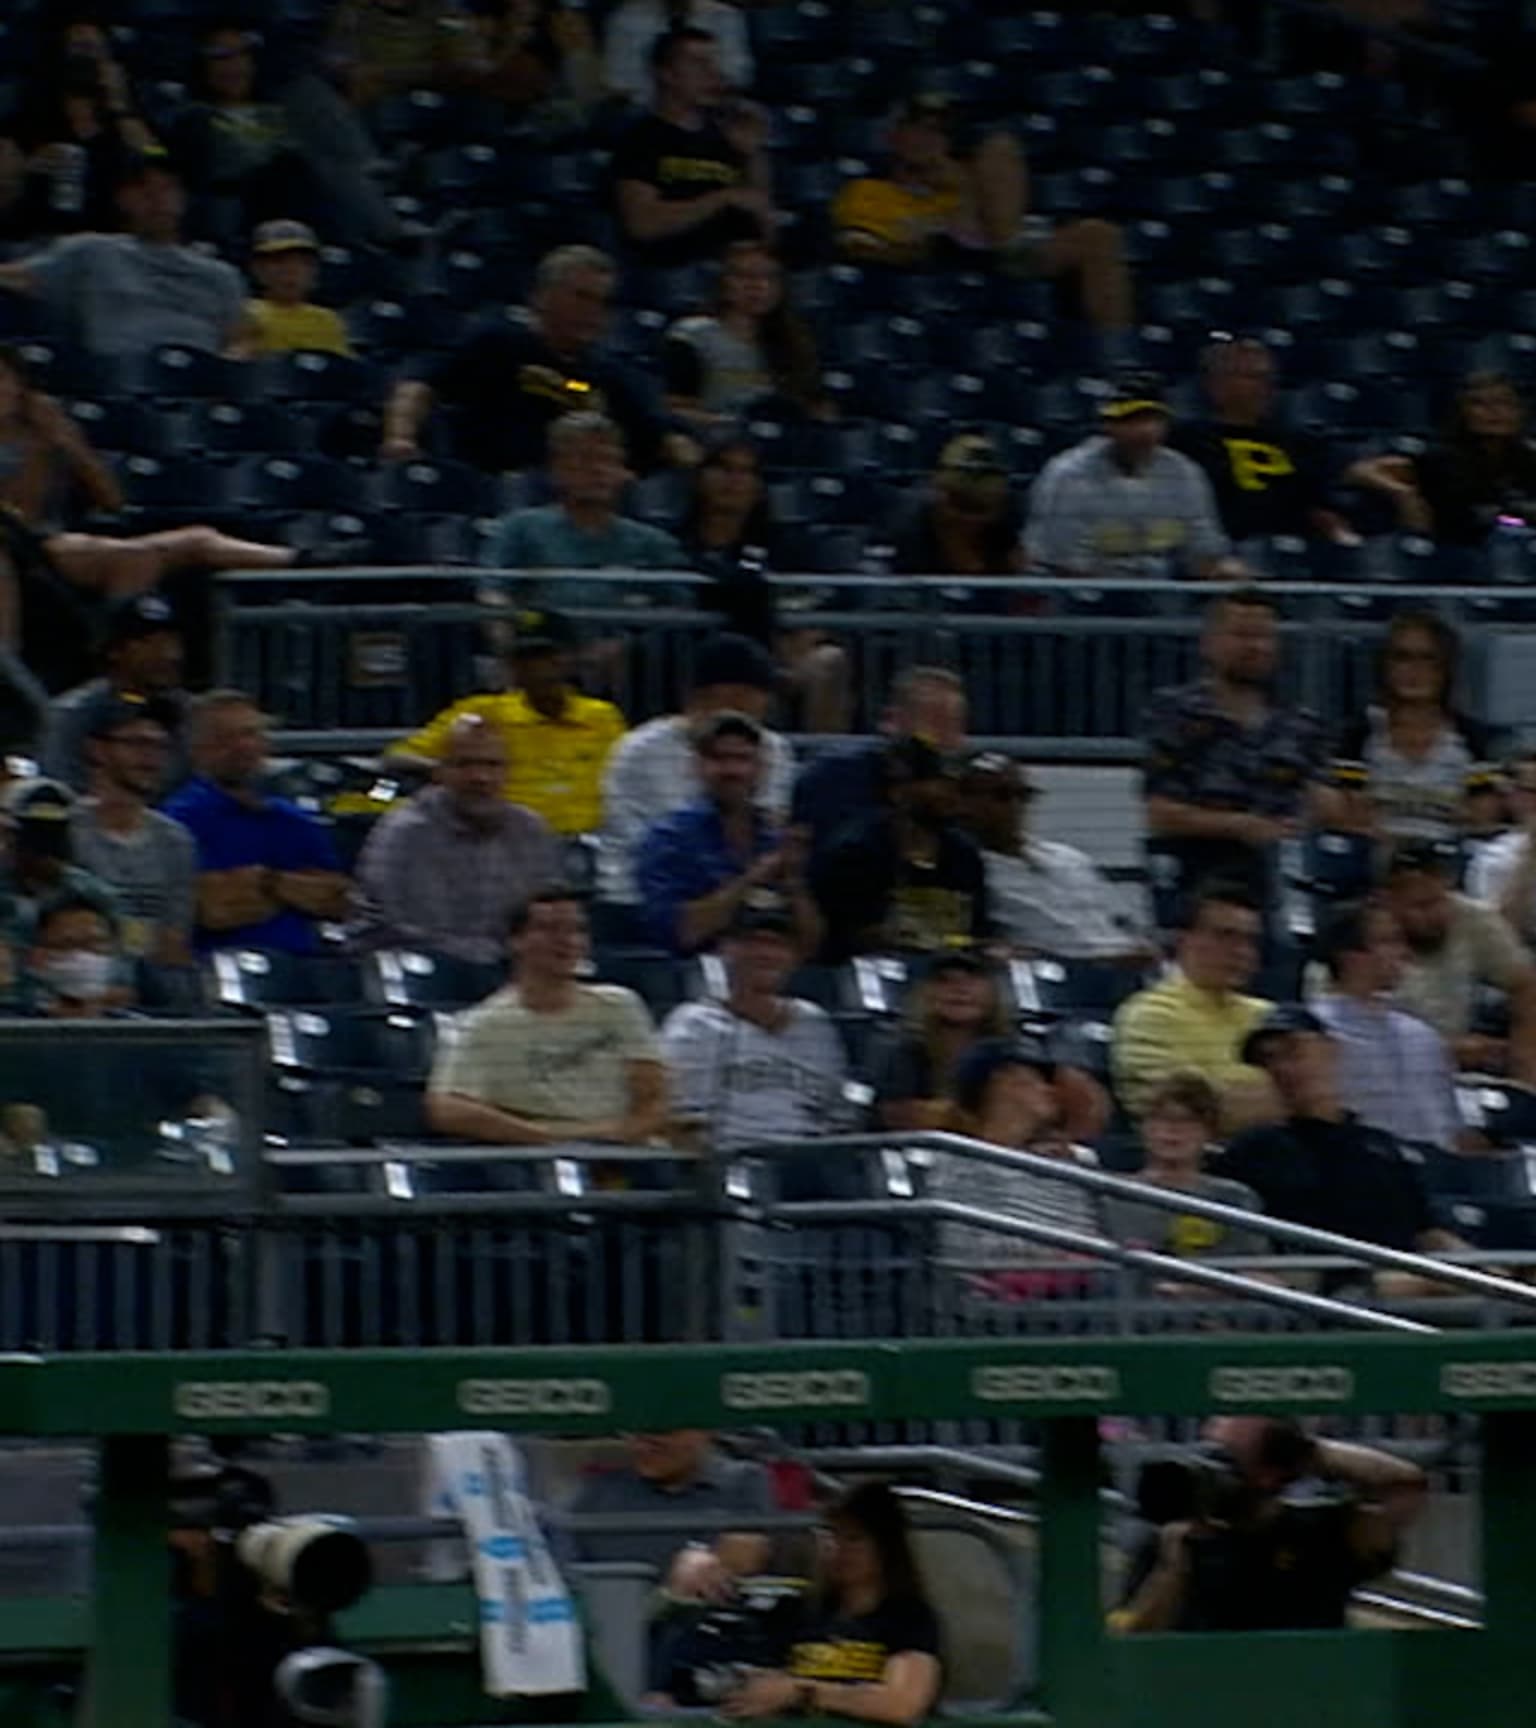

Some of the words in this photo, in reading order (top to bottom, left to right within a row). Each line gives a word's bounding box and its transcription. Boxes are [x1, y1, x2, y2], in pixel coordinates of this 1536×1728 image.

[1219, 437, 1297, 492] P
[174, 1380, 329, 1418] GEICO
[457, 1378, 611, 1416] GEICO
[722, 1371, 869, 1408] GEICO
[972, 1366, 1119, 1401] GEICO
[1211, 1366, 1354, 1402] GEICO
